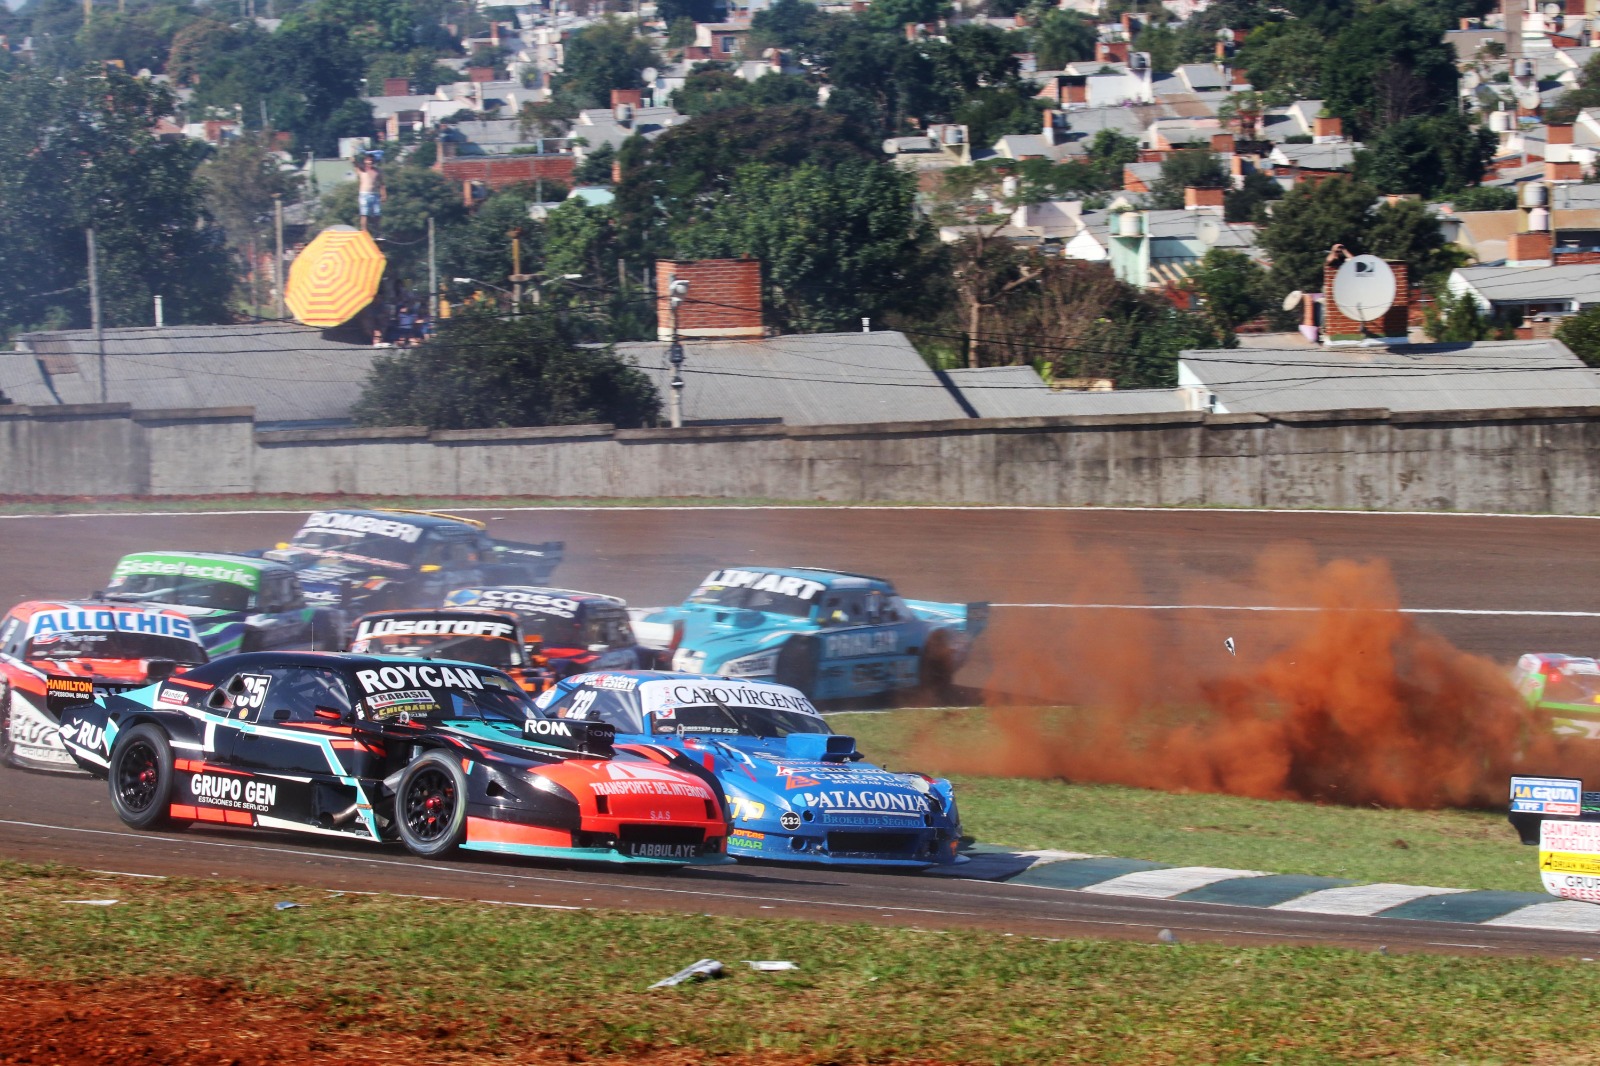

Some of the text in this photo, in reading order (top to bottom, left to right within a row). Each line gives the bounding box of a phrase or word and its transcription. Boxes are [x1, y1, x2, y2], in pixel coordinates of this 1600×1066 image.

[33, 611, 191, 638] ALLOCHIS
[46, 678, 93, 693] HAMILTON
[356, 666, 485, 693] ROYCAN
[370, 691, 430, 703] TRABASIL
[674, 686, 729, 705] CABO
[524, 719, 572, 737] ROM
[191, 774, 276, 806] GRUPO GEN
[589, 781, 710, 800] TRANSPORTE DEL INTERIOR
[1515, 786, 1532, 798] LA
[198, 796, 233, 807] ESTACIONES
[242, 802, 269, 812] SERVICIO
[782, 817, 801, 826] 232
[822, 814, 865, 826] BROKER
[867, 816, 880, 825] DE
[631, 843, 697, 858] LABOULAYE
